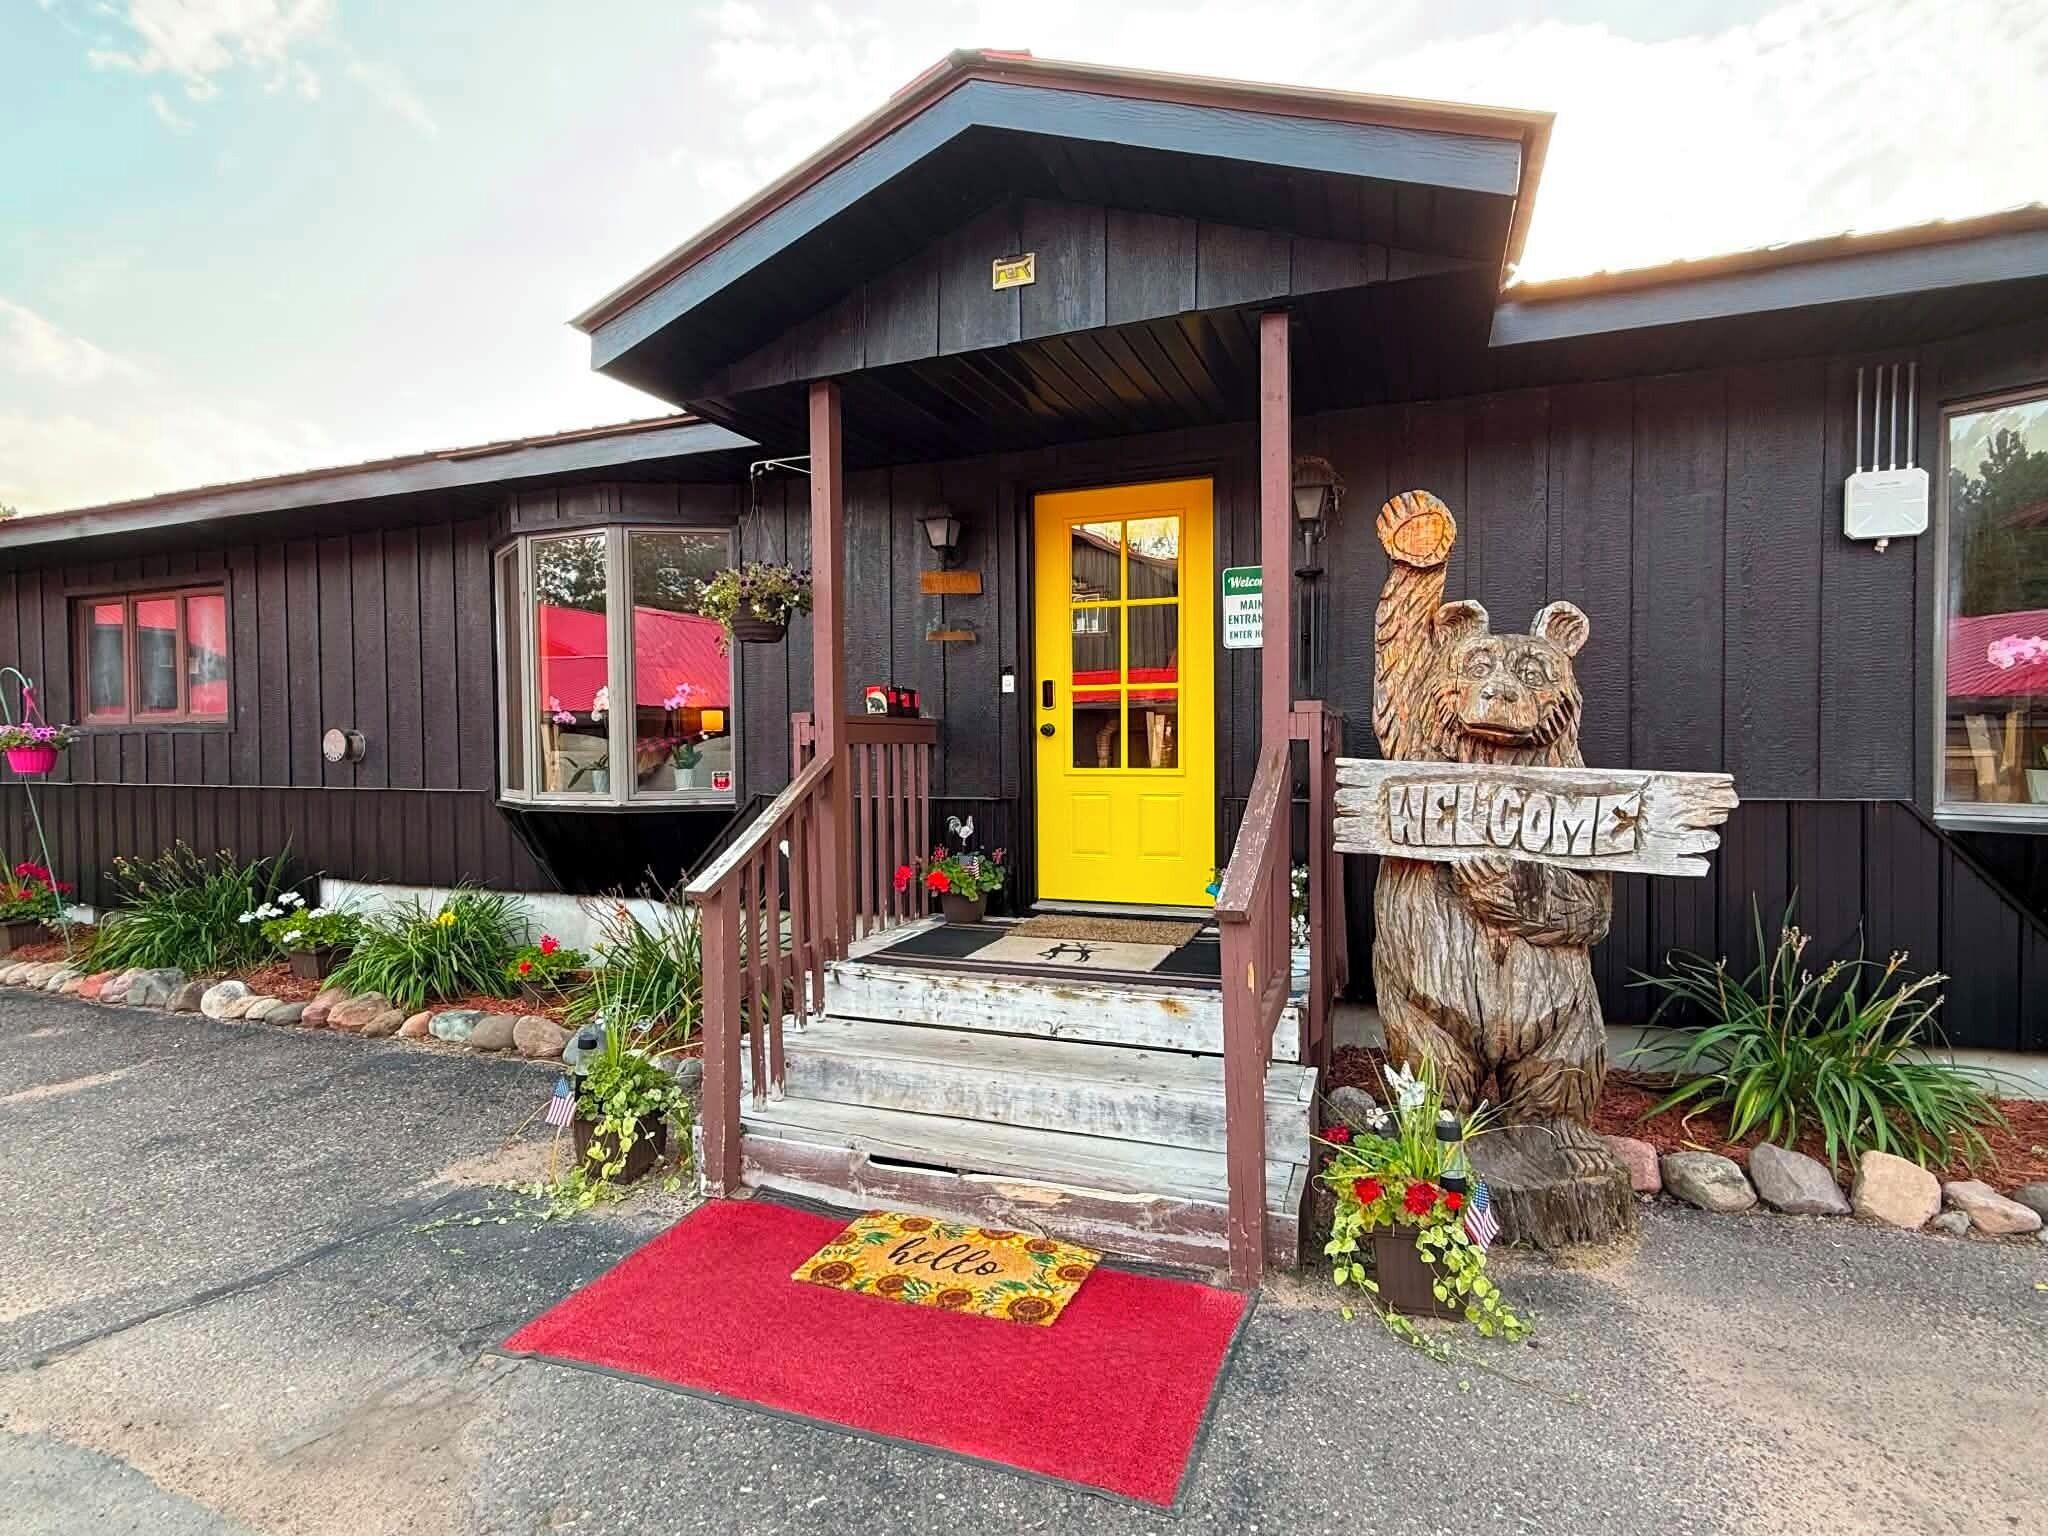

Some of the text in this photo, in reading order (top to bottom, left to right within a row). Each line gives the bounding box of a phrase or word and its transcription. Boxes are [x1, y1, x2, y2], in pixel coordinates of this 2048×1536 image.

[1228, 576, 1263, 588] Welco
[1240, 599, 1263, 610] MAIN
[1228, 613, 1264, 624] ENTRAN
[1229, 630, 1252, 640] ENTER
[1387, 781, 1641, 856] WELCOME
[887, 1236, 1004, 1276] hello
